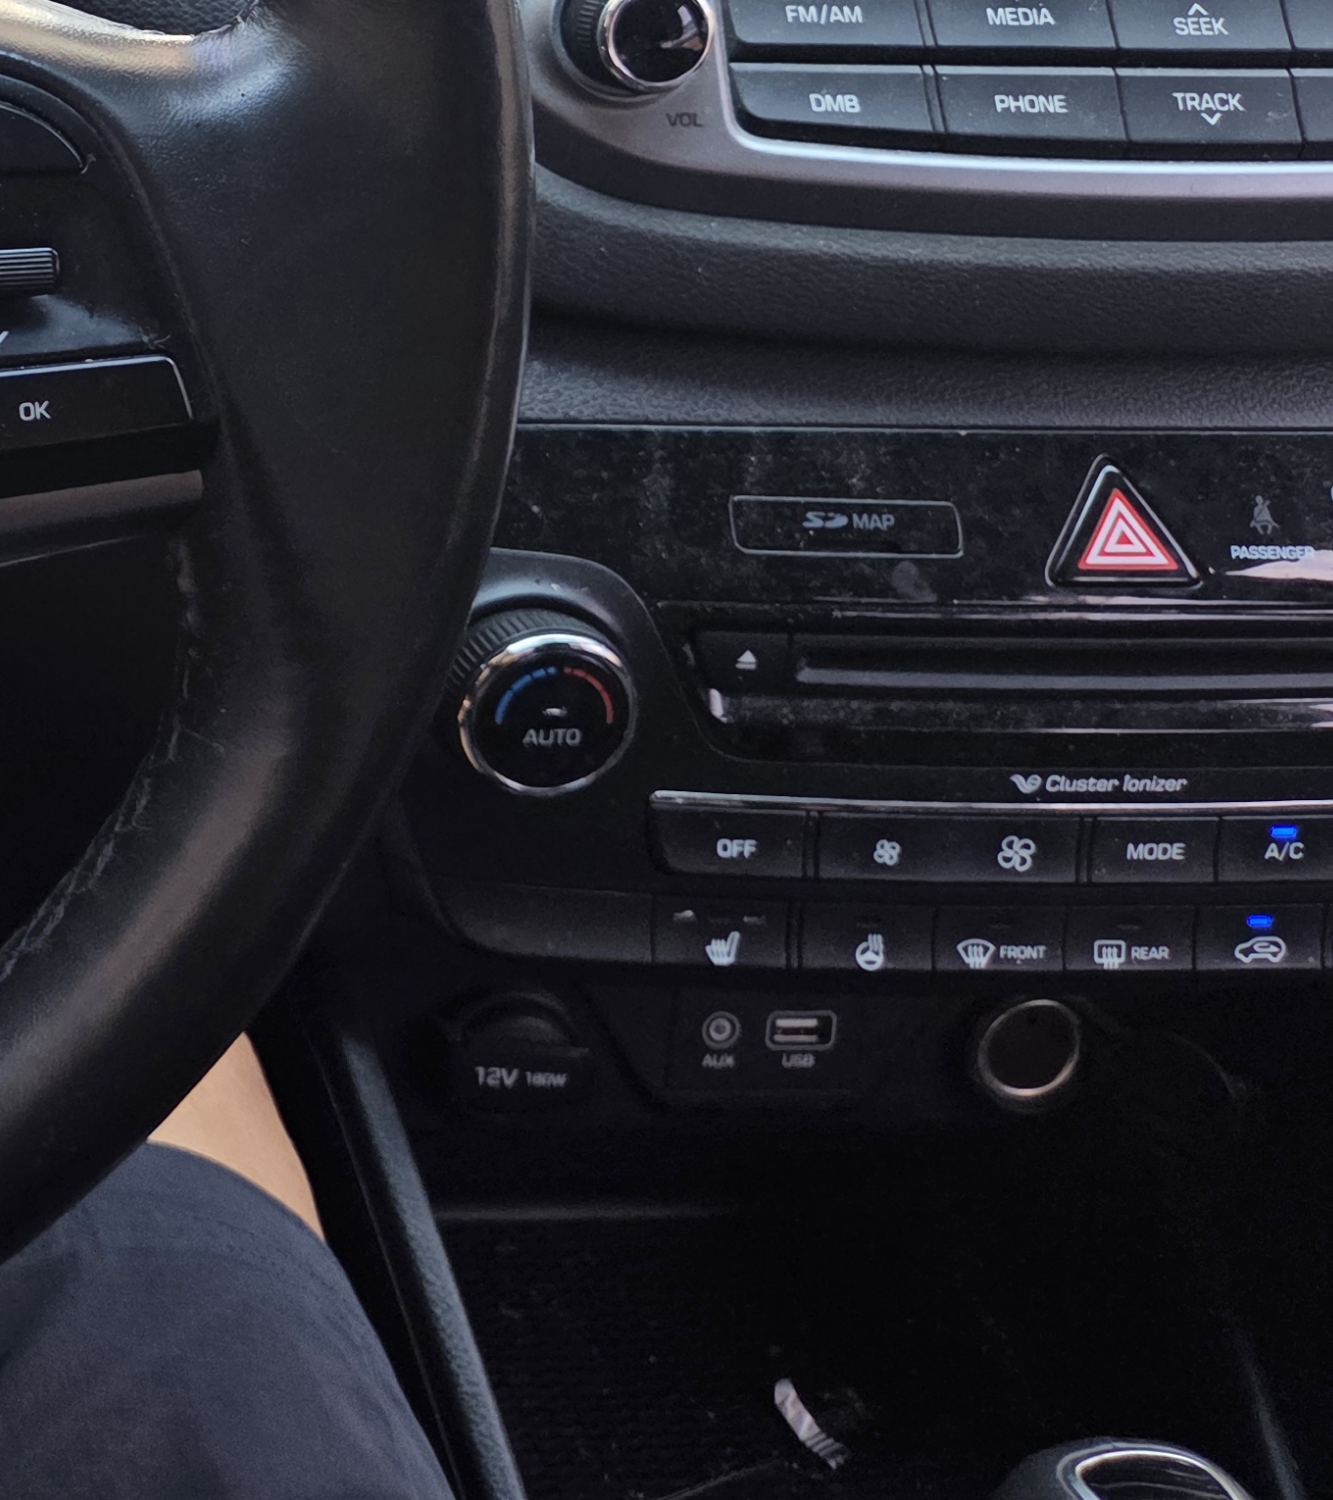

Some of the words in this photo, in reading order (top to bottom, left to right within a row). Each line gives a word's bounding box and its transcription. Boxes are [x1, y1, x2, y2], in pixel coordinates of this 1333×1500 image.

[785, 4, 863, 27] FM/AM
[986, 6, 1055, 28] MEDIA
[1172, 15, 1228, 37] SEEK
[809, 93, 861, 114] DMB
[994, 94, 1068, 115] PHONE
[1172, 91, 1242, 114] TRACK
[666, 112, 703, 128] VOL
[19, 400, 51, 422] OK
[853, 512, 895, 531] MAP
[1230, 544, 1314, 560] PASSENGER
[522, 727, 582, 747] AUTO
[1045, 774, 1119, 794] Cluster
[716, 839, 757, 859] OFF
[1127, 842, 1186, 862] MODE
[1265, 841, 1304, 861] A/C
[999, 945, 1046, 960] FRONT
[1131, 945, 1169, 961] REAR
[782, 1054, 815, 1068] USB
[474, 1066, 519, 1089] 12V
